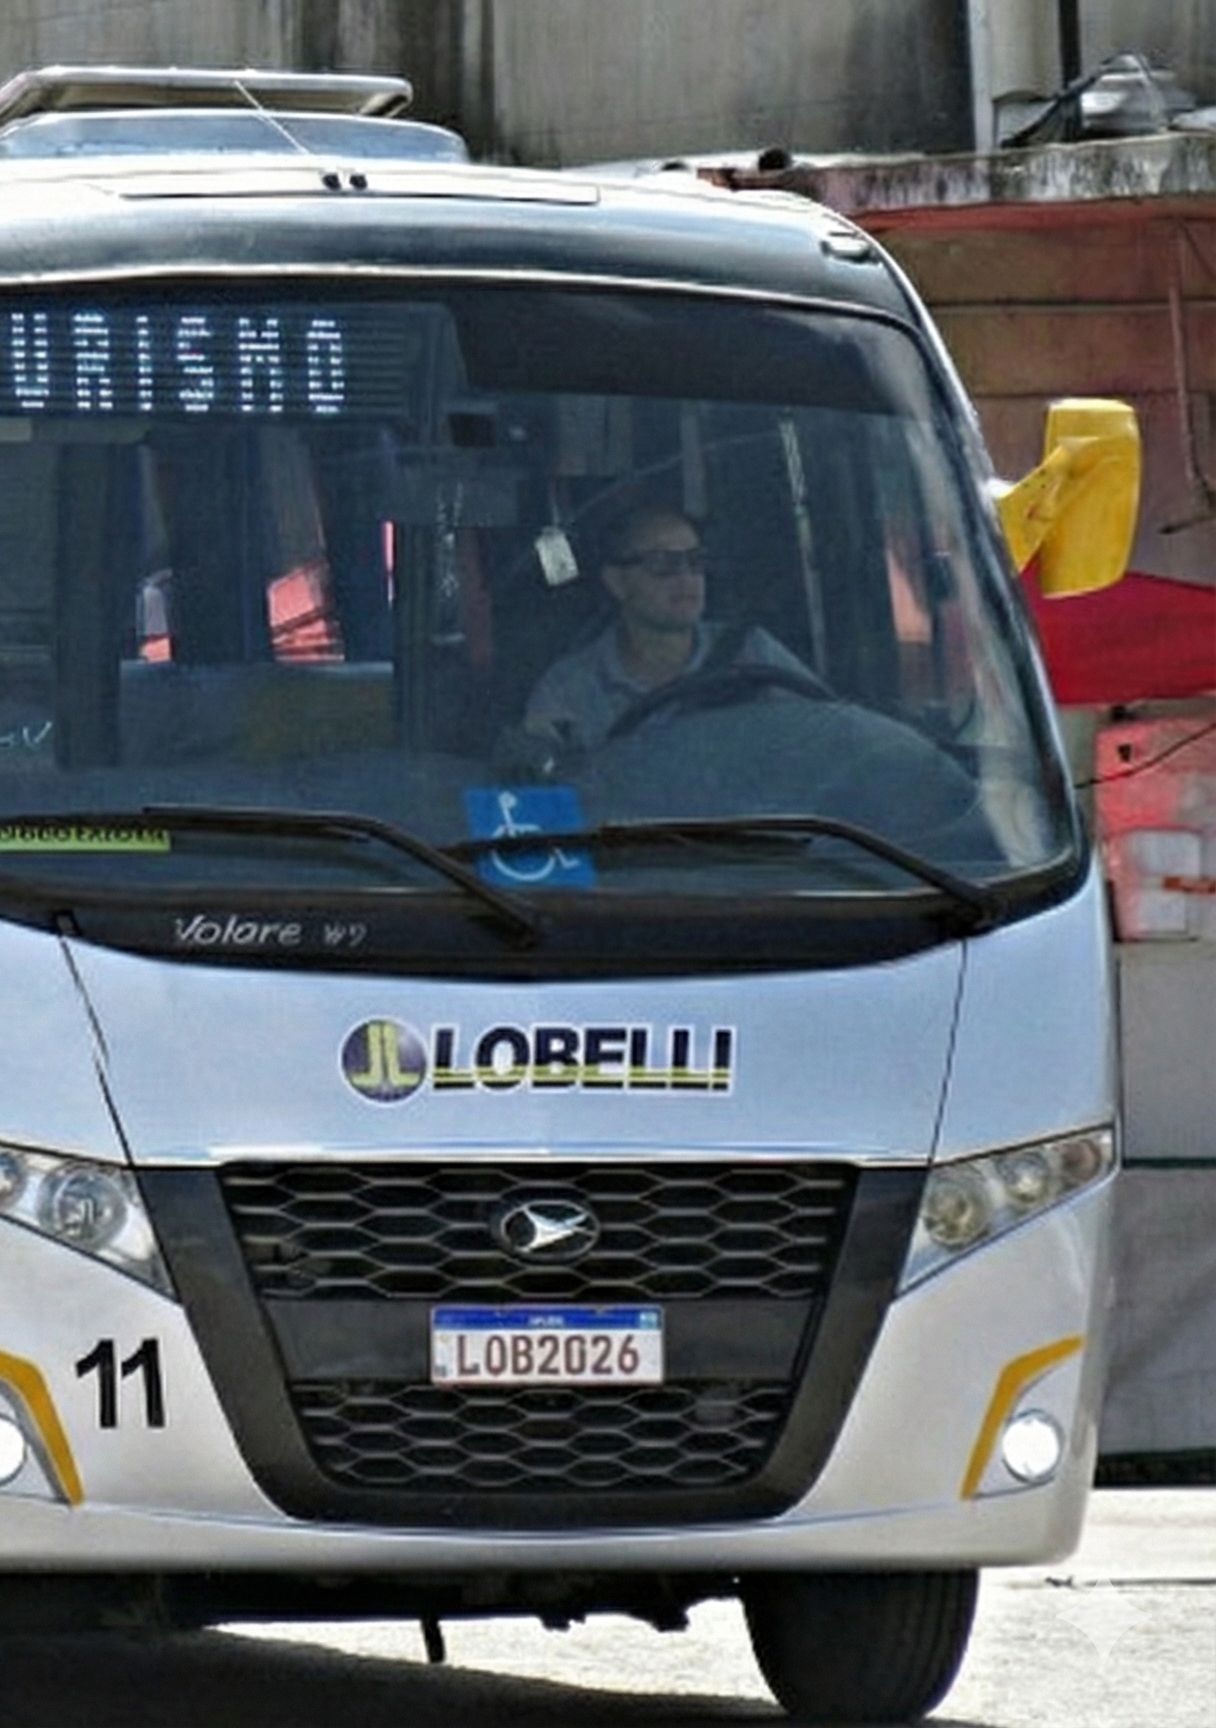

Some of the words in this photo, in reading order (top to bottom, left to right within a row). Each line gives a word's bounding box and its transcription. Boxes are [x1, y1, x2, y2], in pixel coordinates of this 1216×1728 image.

[175, 914, 303, 946] Volare
[432, 1026, 732, 1091] LOBELLI
[456, 1333, 640, 1376] LOB2026
[75, 1338, 165, 1429] 11
